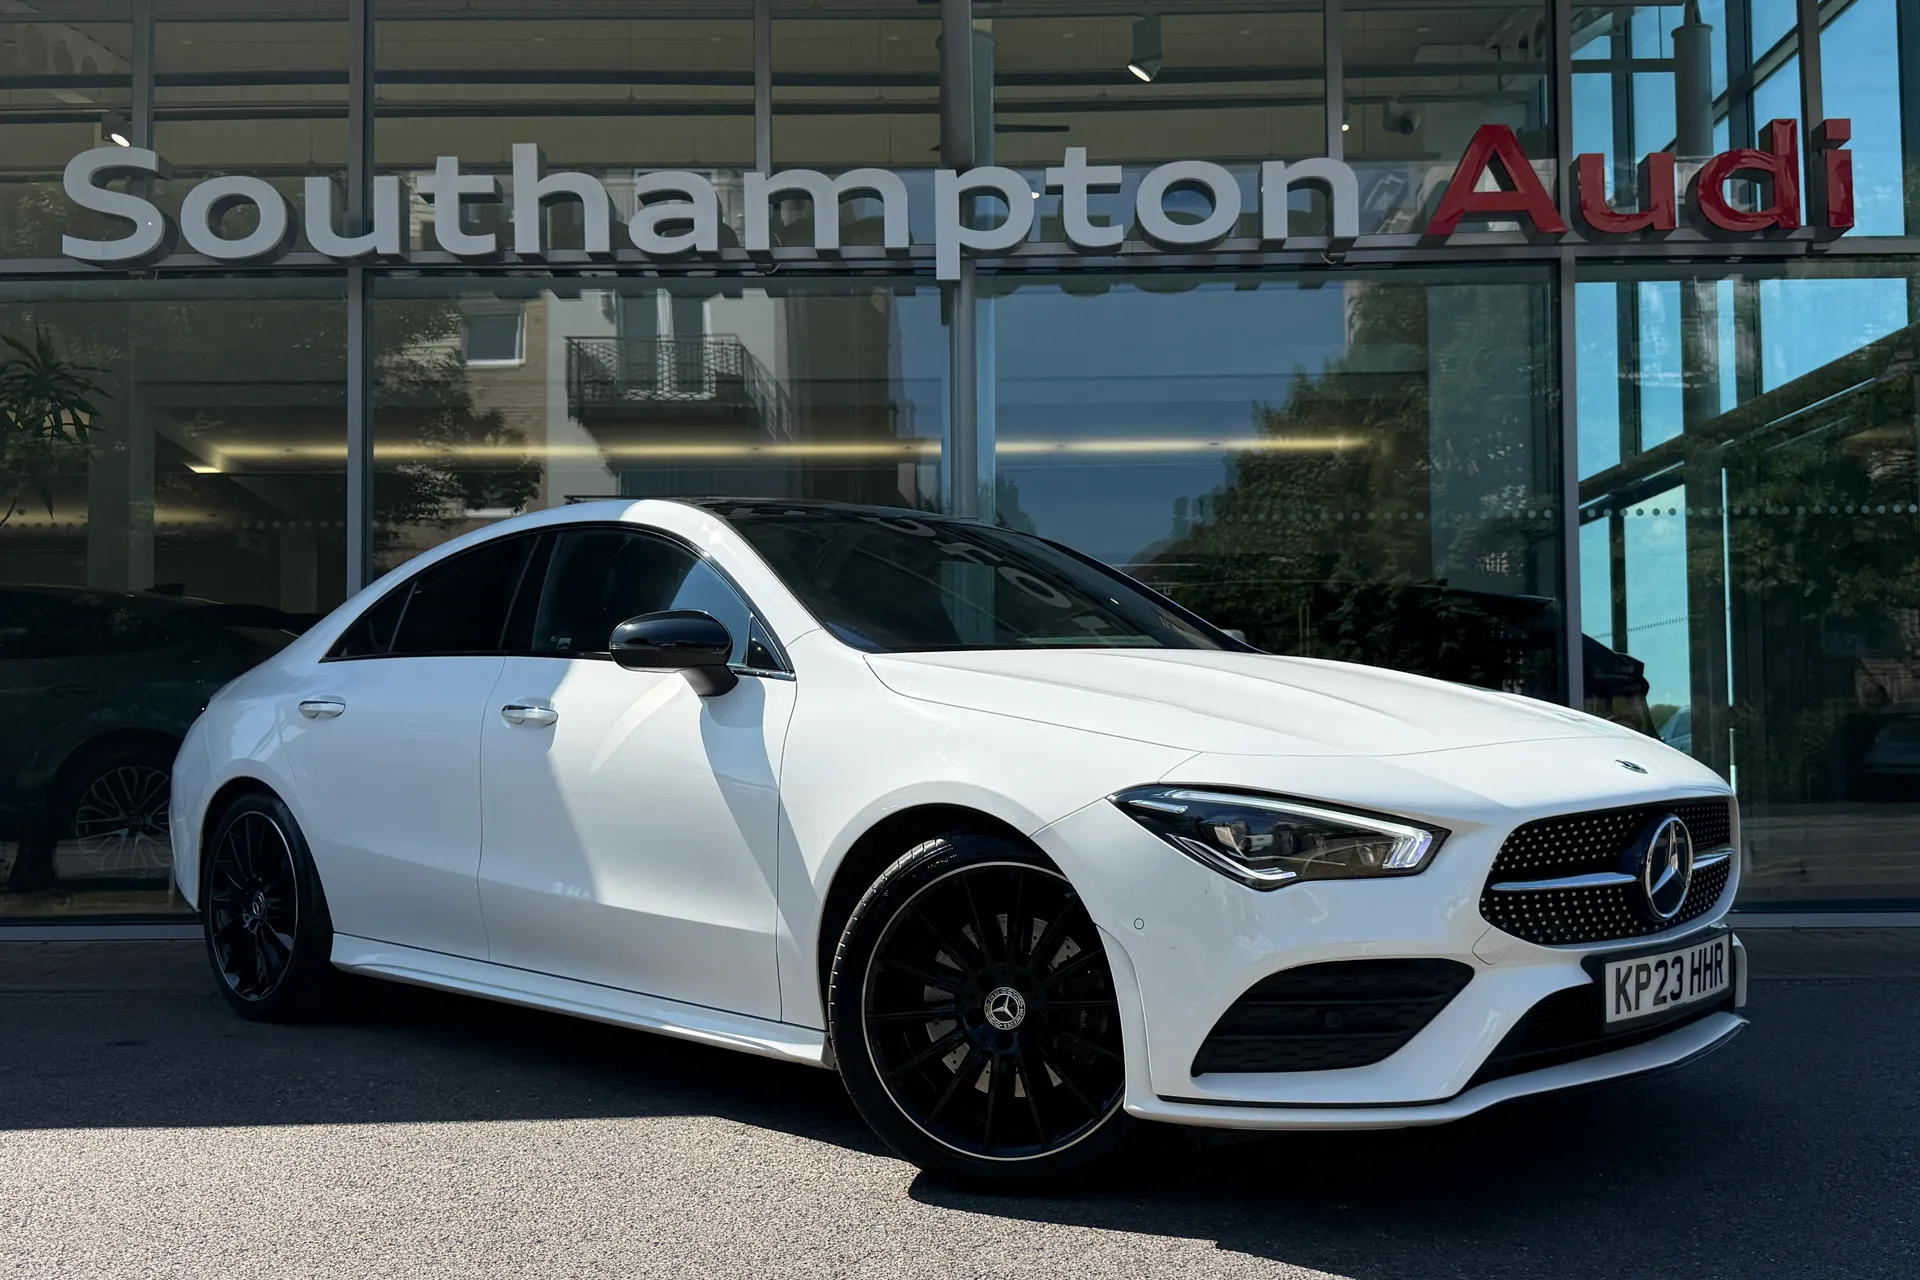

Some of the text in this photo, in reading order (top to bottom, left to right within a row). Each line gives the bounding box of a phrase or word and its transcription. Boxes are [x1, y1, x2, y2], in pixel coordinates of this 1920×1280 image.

[61, 118, 1854, 281] Southampton Audi
[1615, 942, 1724, 1015] KP23 HHR
